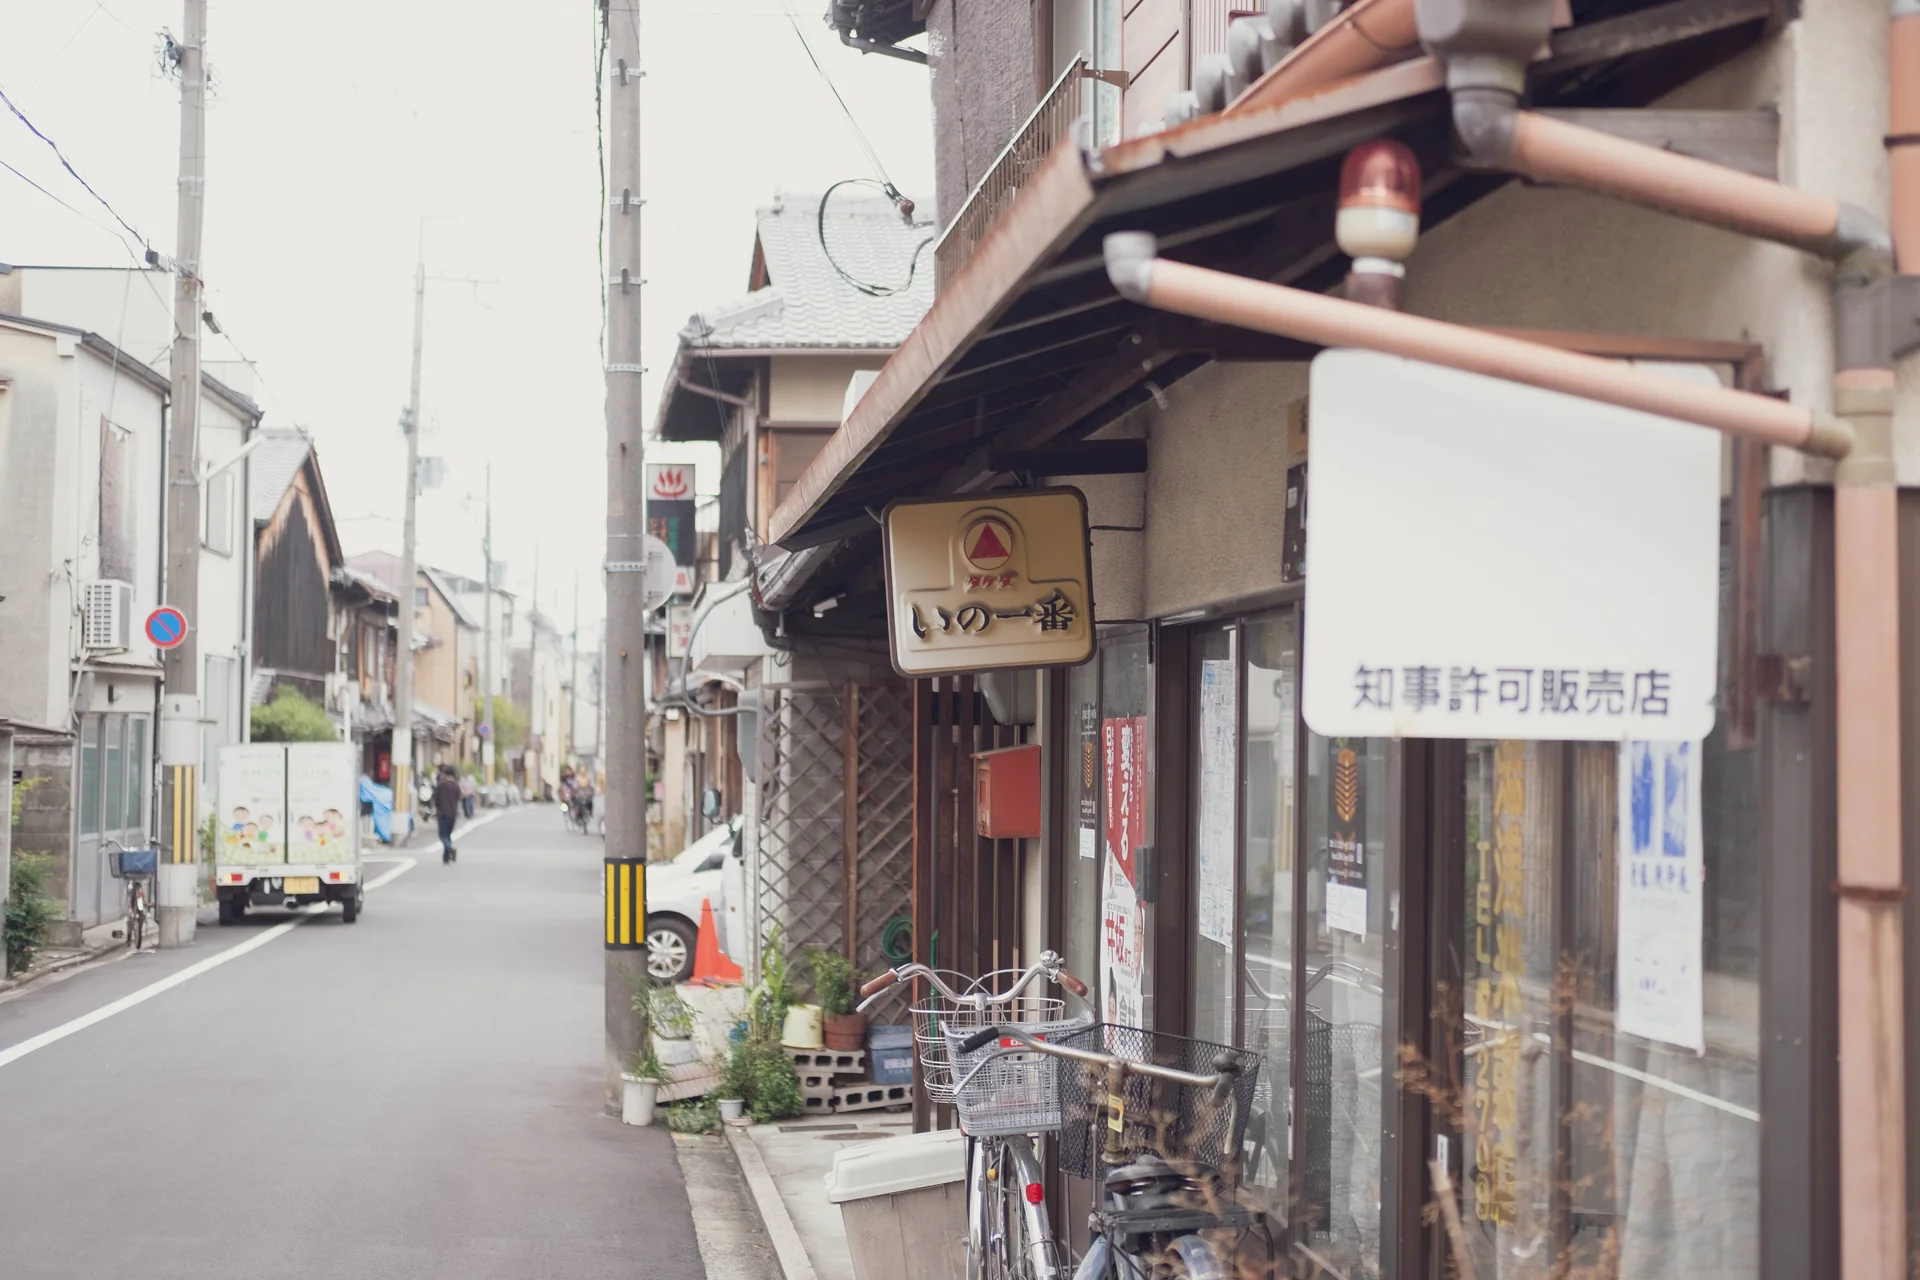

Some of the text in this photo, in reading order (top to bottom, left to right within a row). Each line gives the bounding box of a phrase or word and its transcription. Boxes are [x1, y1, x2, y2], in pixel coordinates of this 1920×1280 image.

[911, 592, 1075, 640] いの一番
[1355, 664, 1670, 716] 知事許可販売店
